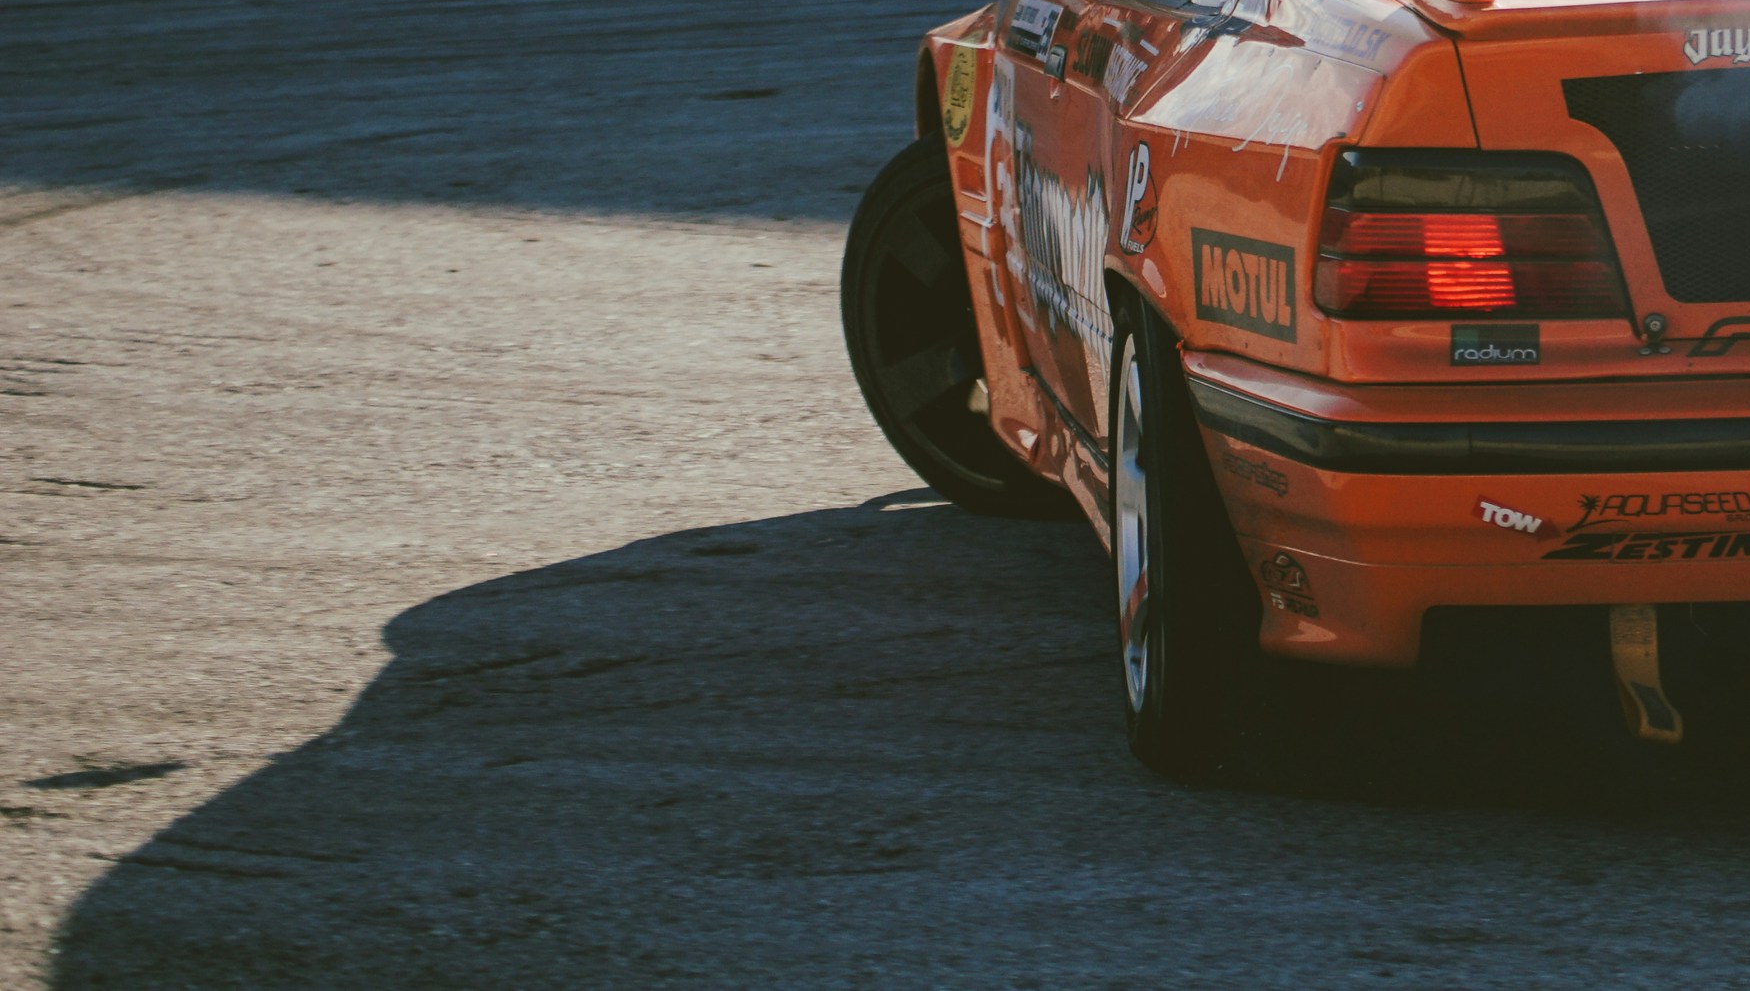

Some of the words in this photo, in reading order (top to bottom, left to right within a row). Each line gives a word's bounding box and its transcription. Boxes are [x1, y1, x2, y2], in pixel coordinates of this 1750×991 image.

[1201, 244, 1291, 327] MOTUL
[1454, 344, 1537, 361] radium
[1479, 501, 1542, 534] TOW
